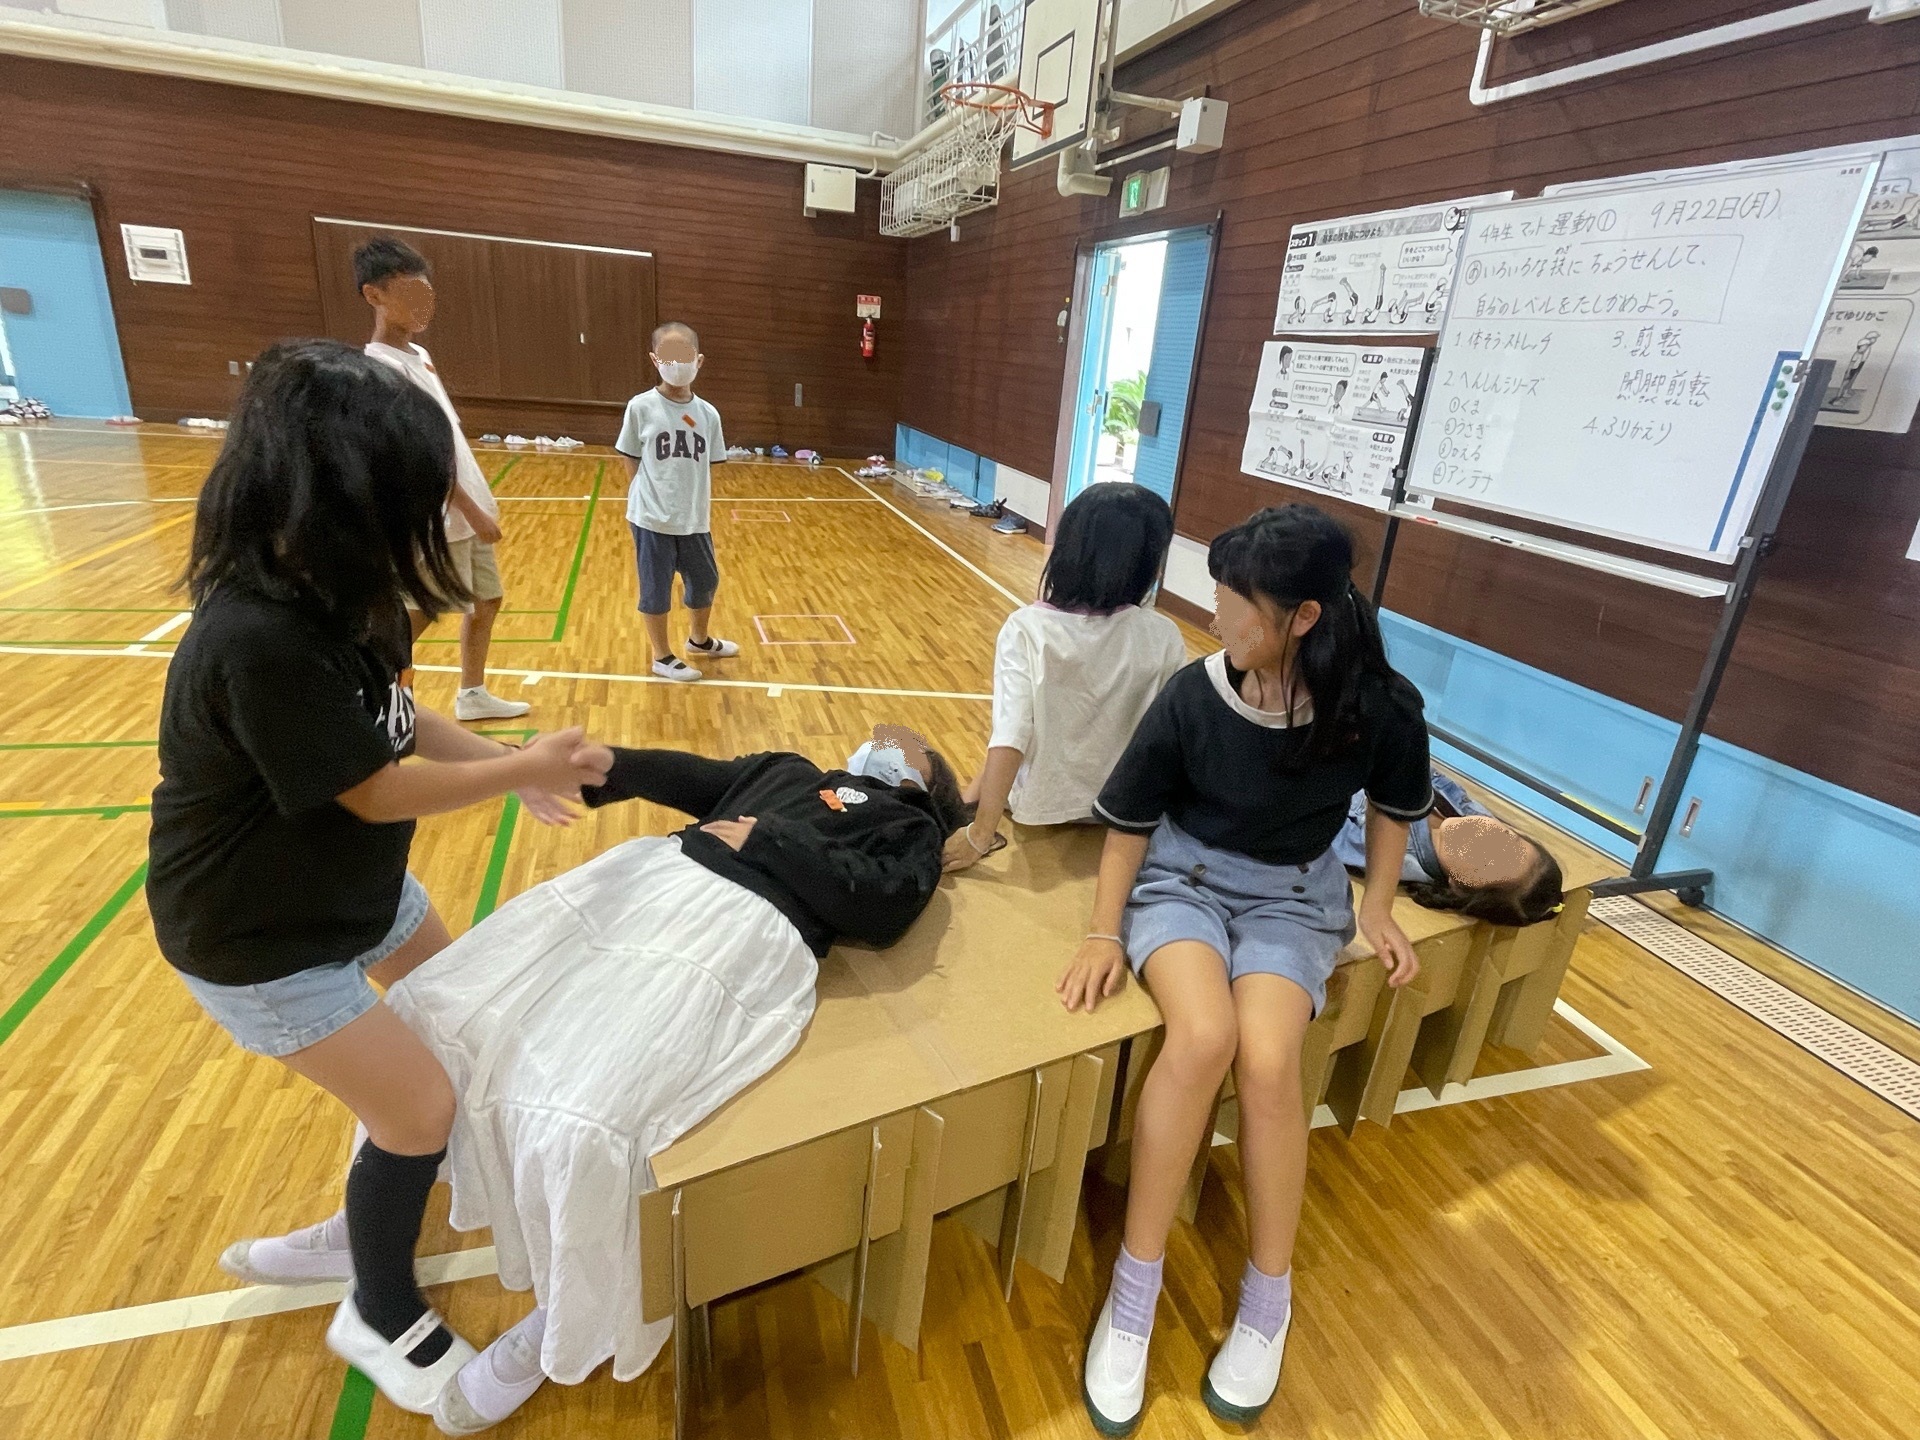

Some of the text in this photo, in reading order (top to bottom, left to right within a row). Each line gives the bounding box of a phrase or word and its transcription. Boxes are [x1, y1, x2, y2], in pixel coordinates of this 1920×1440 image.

[1651, 188, 1781, 228] 9月22日(月)
[655, 429, 707, 462] GAP
